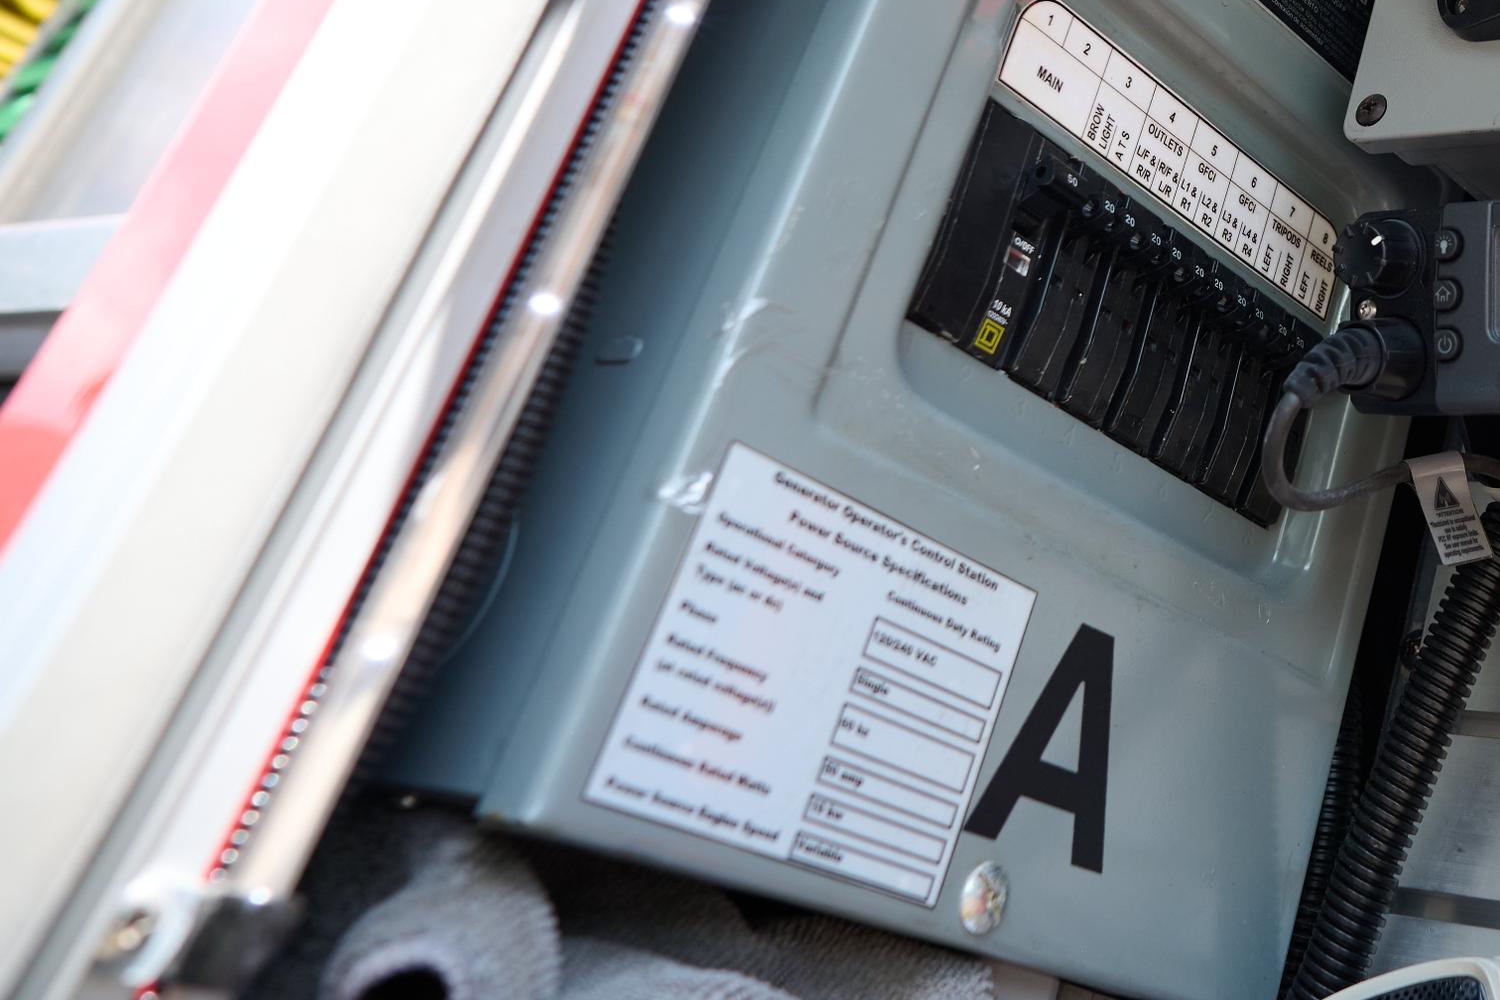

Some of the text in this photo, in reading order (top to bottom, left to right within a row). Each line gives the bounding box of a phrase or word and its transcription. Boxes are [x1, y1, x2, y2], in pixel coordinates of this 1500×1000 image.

[1046, 13, 1054, 26] 1
[1083, 42, 1092, 56] 2
[1036, 64, 1064, 93] MAIN
[1124, 76, 1132, 89] 3
[1086, 103, 1106, 142] BROW
[1168, 110, 1176, 124] 4
[1097, 113, 1116, 150] LIGHT
[1147, 122, 1184, 158] OUTLETS
[1136, 144, 1157, 168] L/F &
[1210, 144, 1218, 157] 5
[1068, 174, 1079, 187] 50
[1136, 163, 1151, 182] R/R
[1158, 160, 1179, 185] R/F &
[1197, 162, 1216, 183] GFCI
[1157, 180, 1172, 198] L/R
[1180, 178, 1198, 198] L1 &
[1250, 176, 1257, 189] 6
[1104, 201, 1115, 214] 20
[1180, 196, 1191, 212] R1
[1201, 194, 1218, 213] L2 &
[1238, 192, 1256, 214] GFCI
[1125, 214, 1135, 227] 20
[1200, 212, 1212, 228] R2
[1221, 209, 1238, 229] L3 &
[1289, 206, 1295, 219] 7
[1152, 233, 1161, 246] 20
[1221, 228, 1232, 243] R3
[1241, 224, 1258, 244] L4 &
[1270, 218, 1301, 249] TRIPODS
[1322, 231, 1328, 245] 8
[1172, 247, 1182, 260] 20
[1241, 243, 1252, 258] R4
[1261, 244, 1274, 273] LEFT
[1280, 252, 1294, 288] RIGHT
[1310, 249, 1332, 273] REELS
[1195, 265, 1204, 278] 20
[1214, 278, 1224, 291] 20
[1298, 271, 1310, 300] LEFT
[992, 299, 1003, 311] 10
[1237, 295, 1247, 307] 20
[1314, 279, 1328, 313] RIGHT
[1255, 307, 1264, 320] 20
[1278, 324, 1287, 337] 20
[772, 469, 1000, 593] Generator Operator's Control Station
[787, 509, 969, 607] Power Source Specifications
[885, 589, 1001, 653] Continuous Duty Rating
[914, 648, 938, 667] VAC
[963, 622, 1116, 874] A
